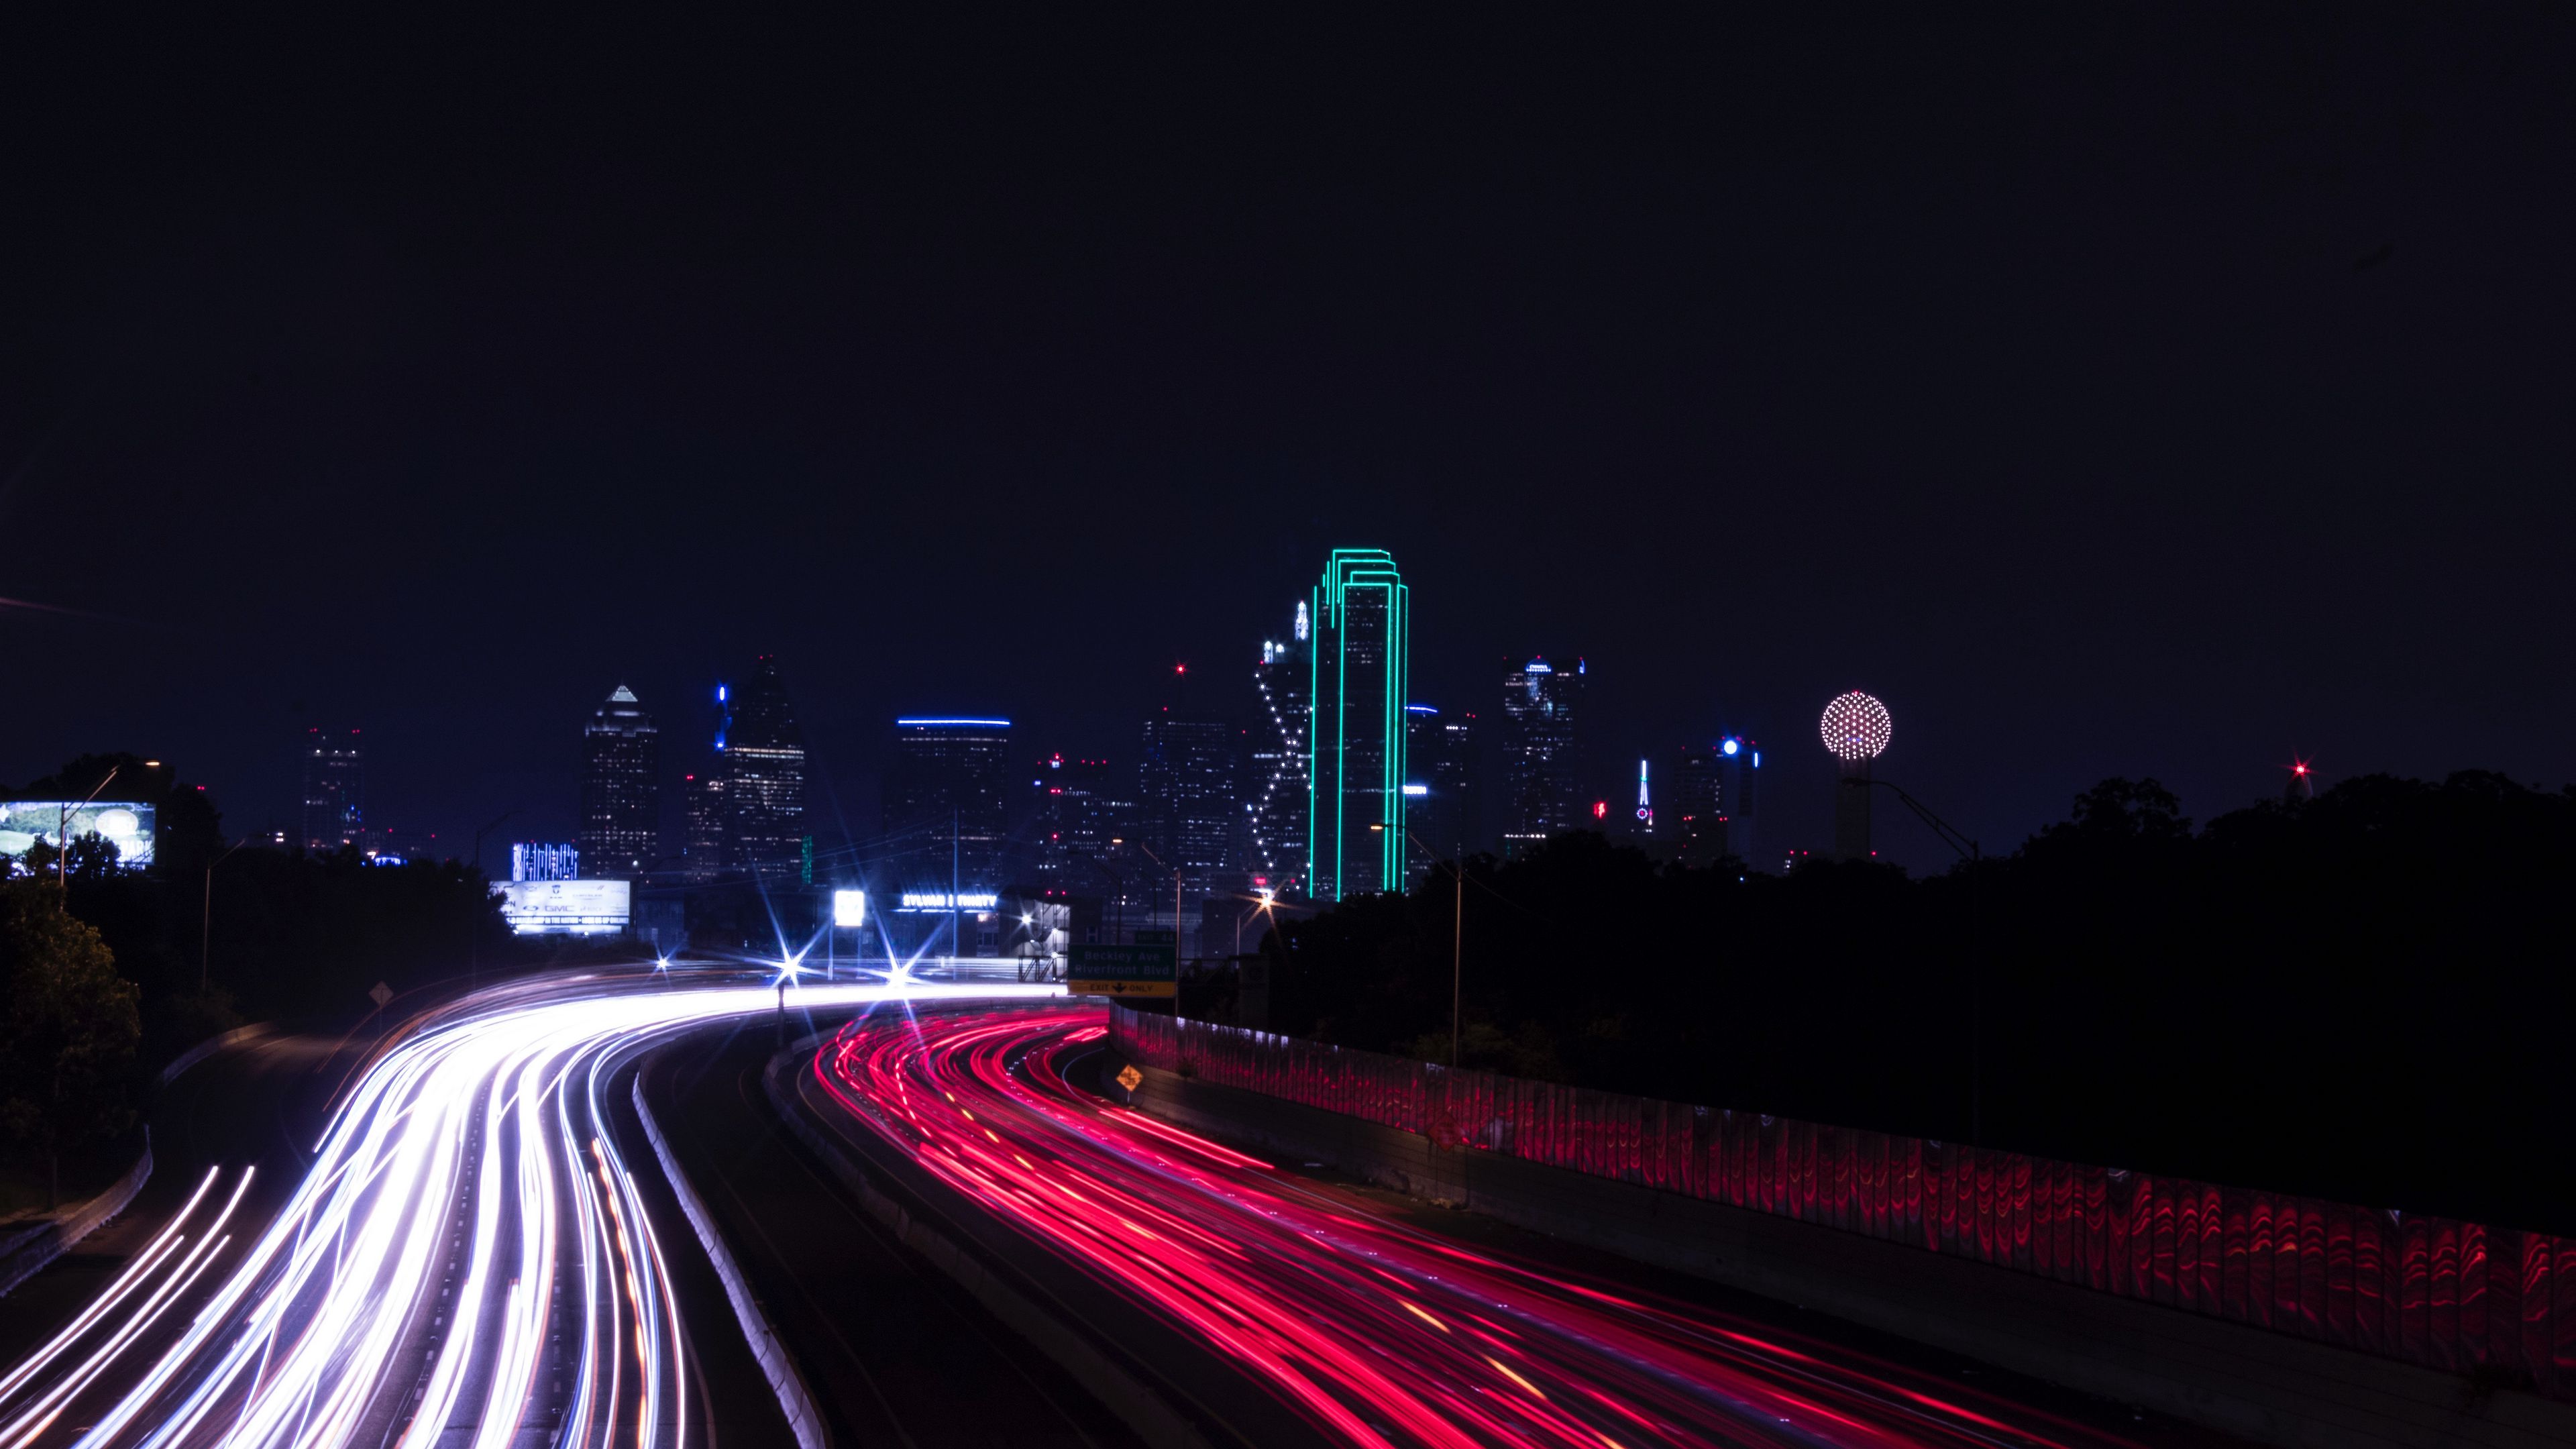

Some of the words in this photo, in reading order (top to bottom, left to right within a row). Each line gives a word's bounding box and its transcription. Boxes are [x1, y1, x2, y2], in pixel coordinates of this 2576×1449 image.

[1084, 951, 1132, 963] Beckley
[1138, 951, 1161, 961] Ave
[1074, 963, 1138, 974] Riverfront
[1143, 965, 1170, 975] Blvd
[1089, 983, 1109, 991] EXIT
[1128, 984, 1154, 992] ONLY
